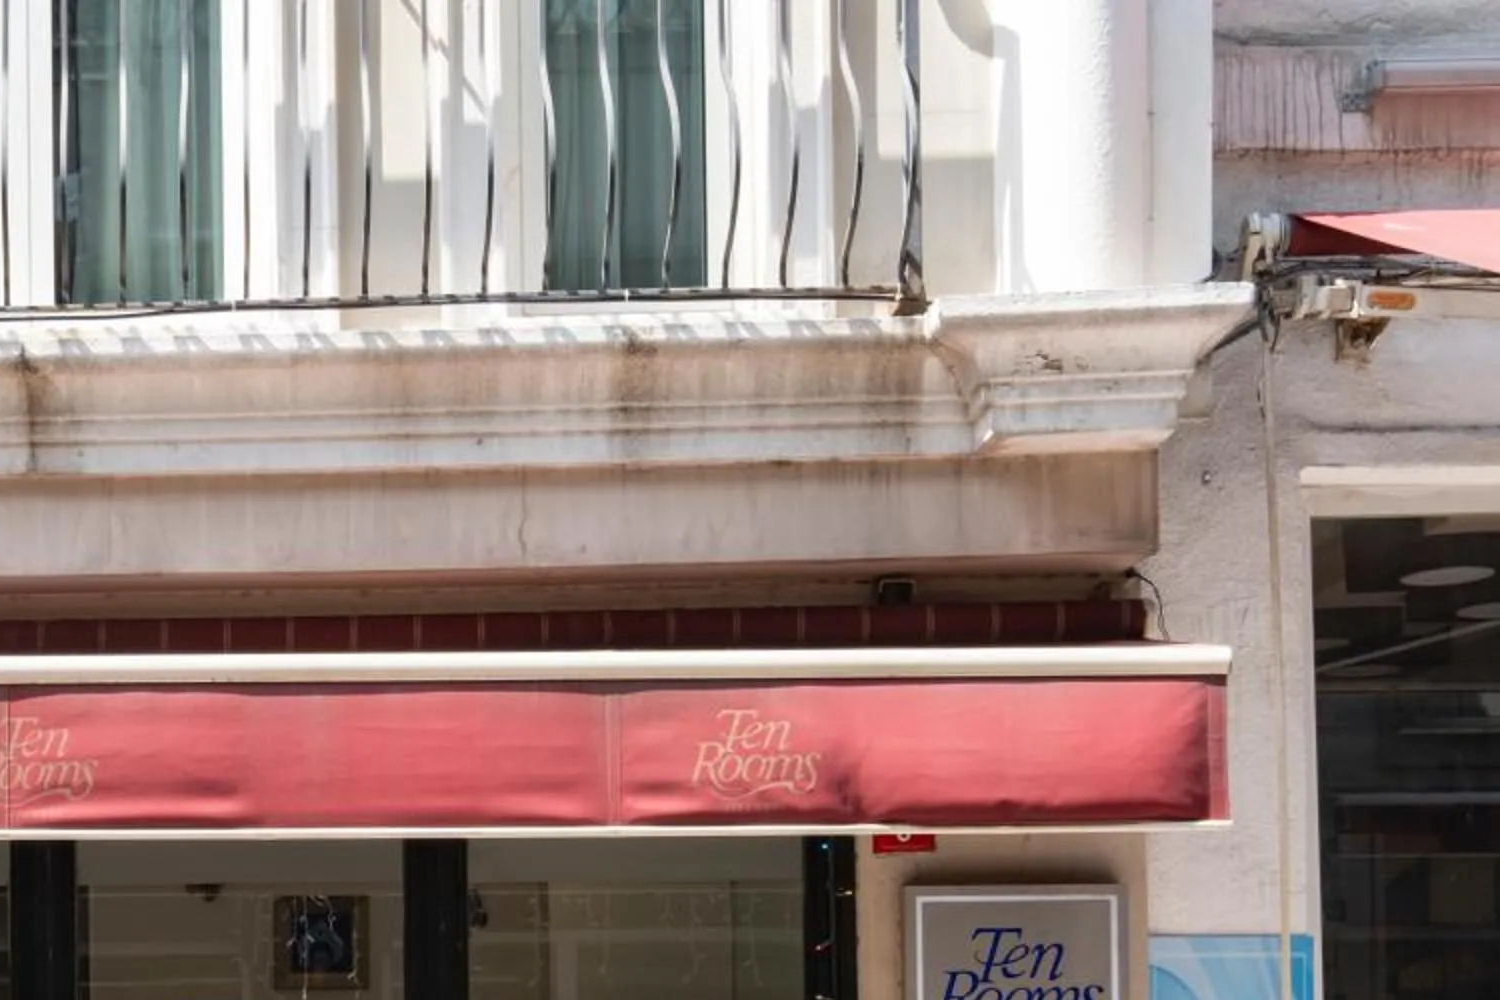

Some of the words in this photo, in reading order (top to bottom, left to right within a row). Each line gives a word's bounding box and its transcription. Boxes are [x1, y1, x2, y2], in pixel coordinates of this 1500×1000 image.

[0, 716, 70, 760] Ten
[716, 708, 791, 752] Ten
[690, 741, 821, 800] Rooms
[971, 927, 1065, 984] Ten
